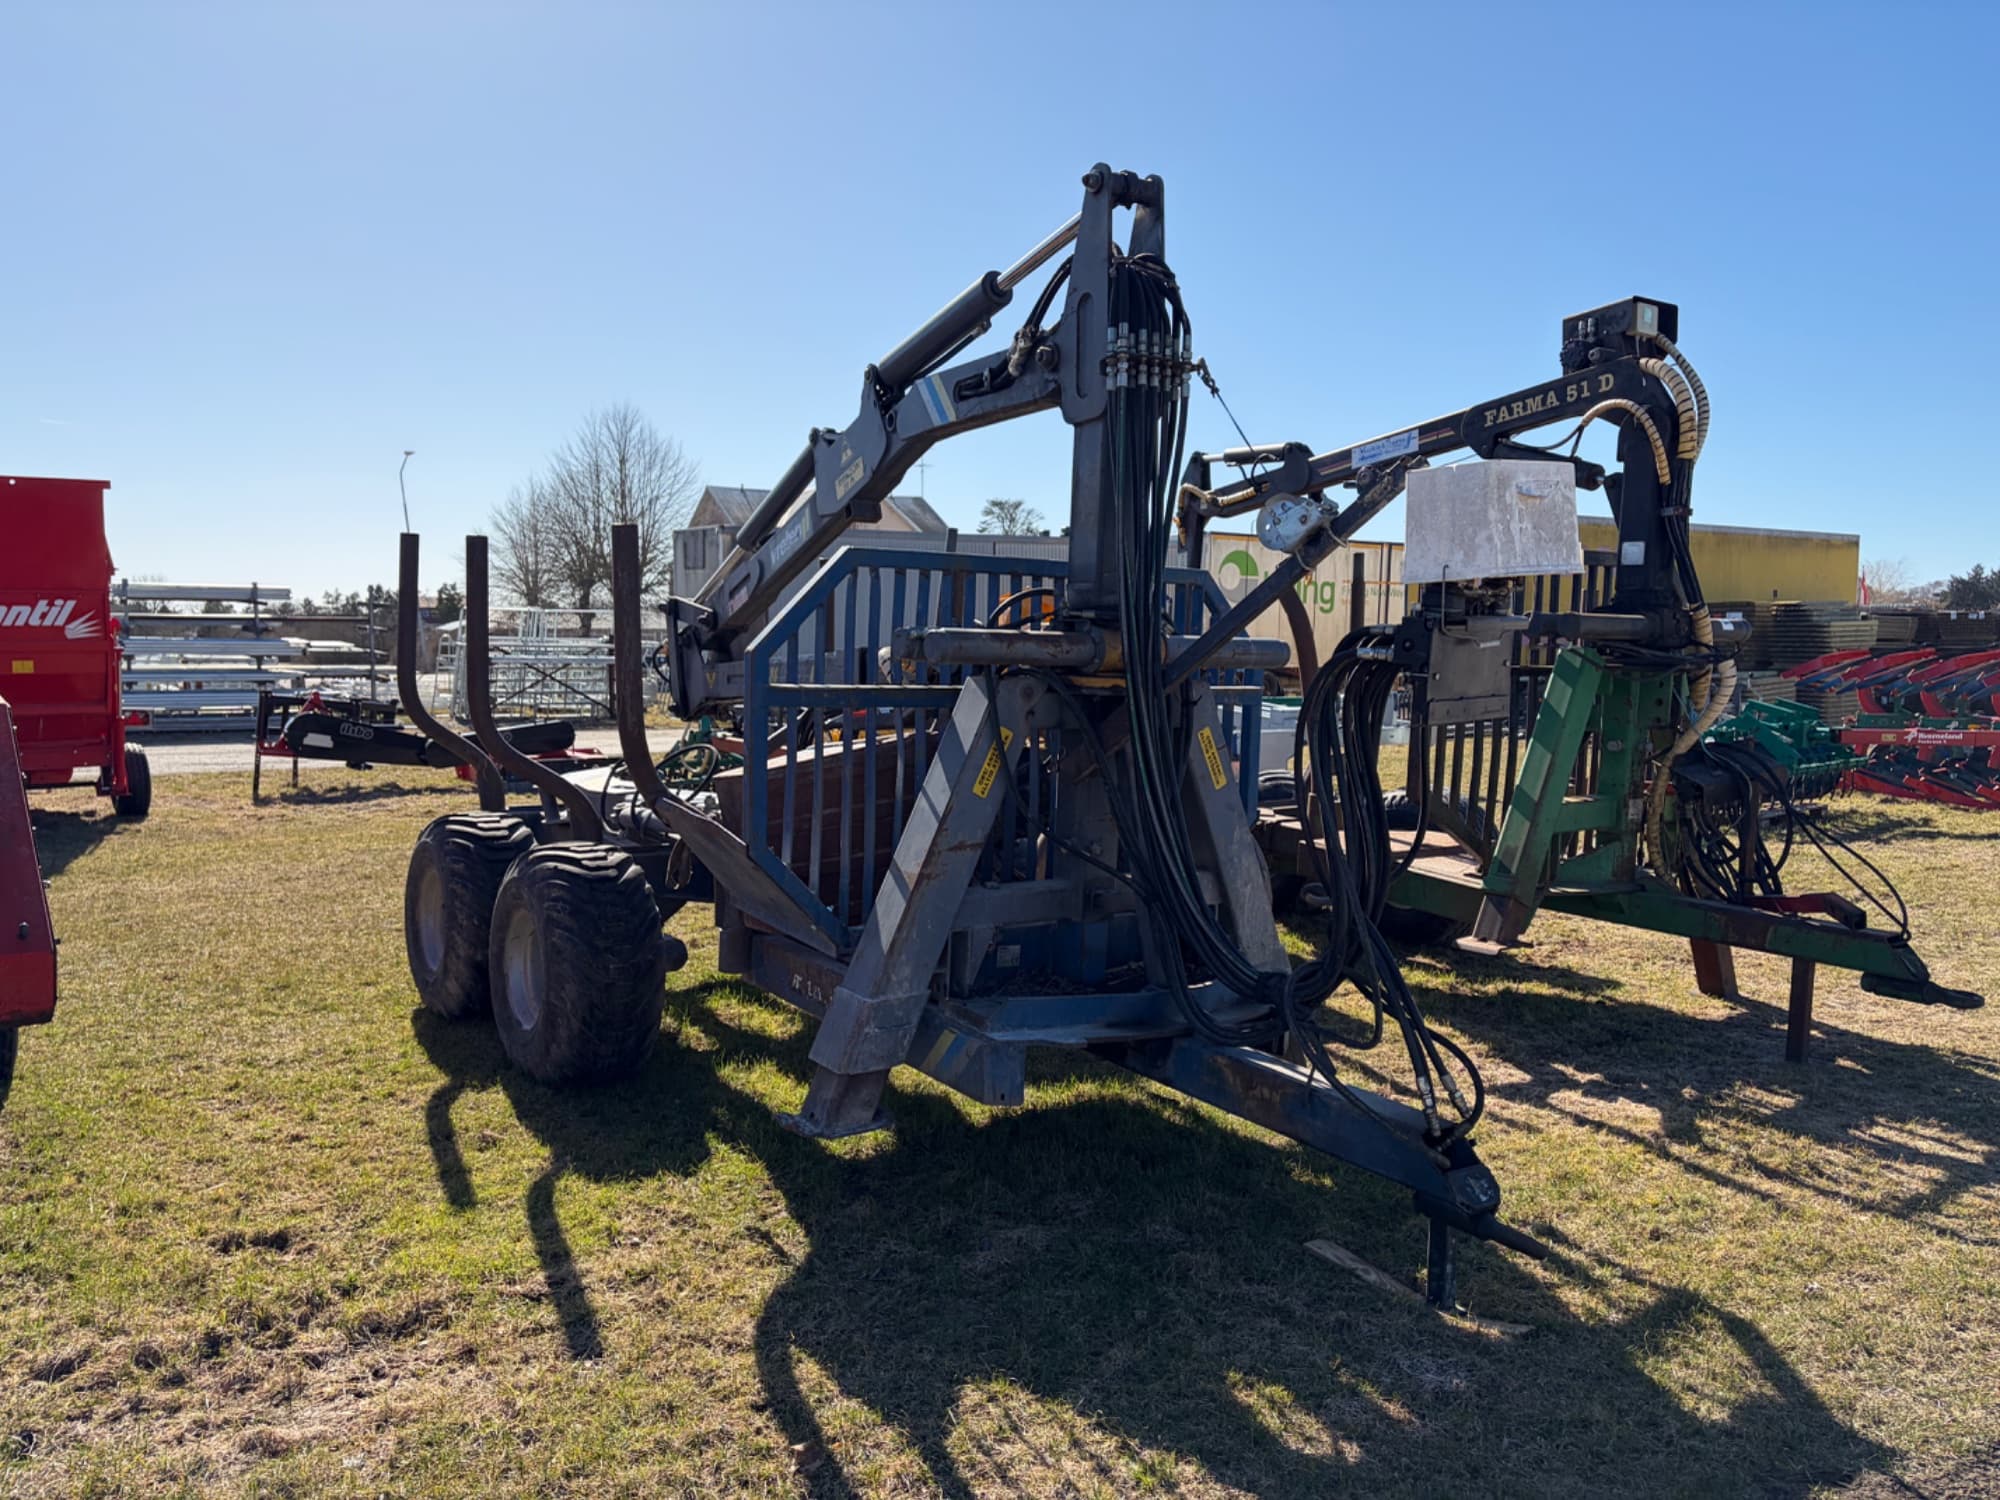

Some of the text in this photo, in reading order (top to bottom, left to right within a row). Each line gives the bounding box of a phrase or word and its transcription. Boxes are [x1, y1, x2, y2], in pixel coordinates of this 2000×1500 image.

[1484, 373, 1615, 428] FARMA 51 D
[1918, 732, 1963, 741] Kverneland
